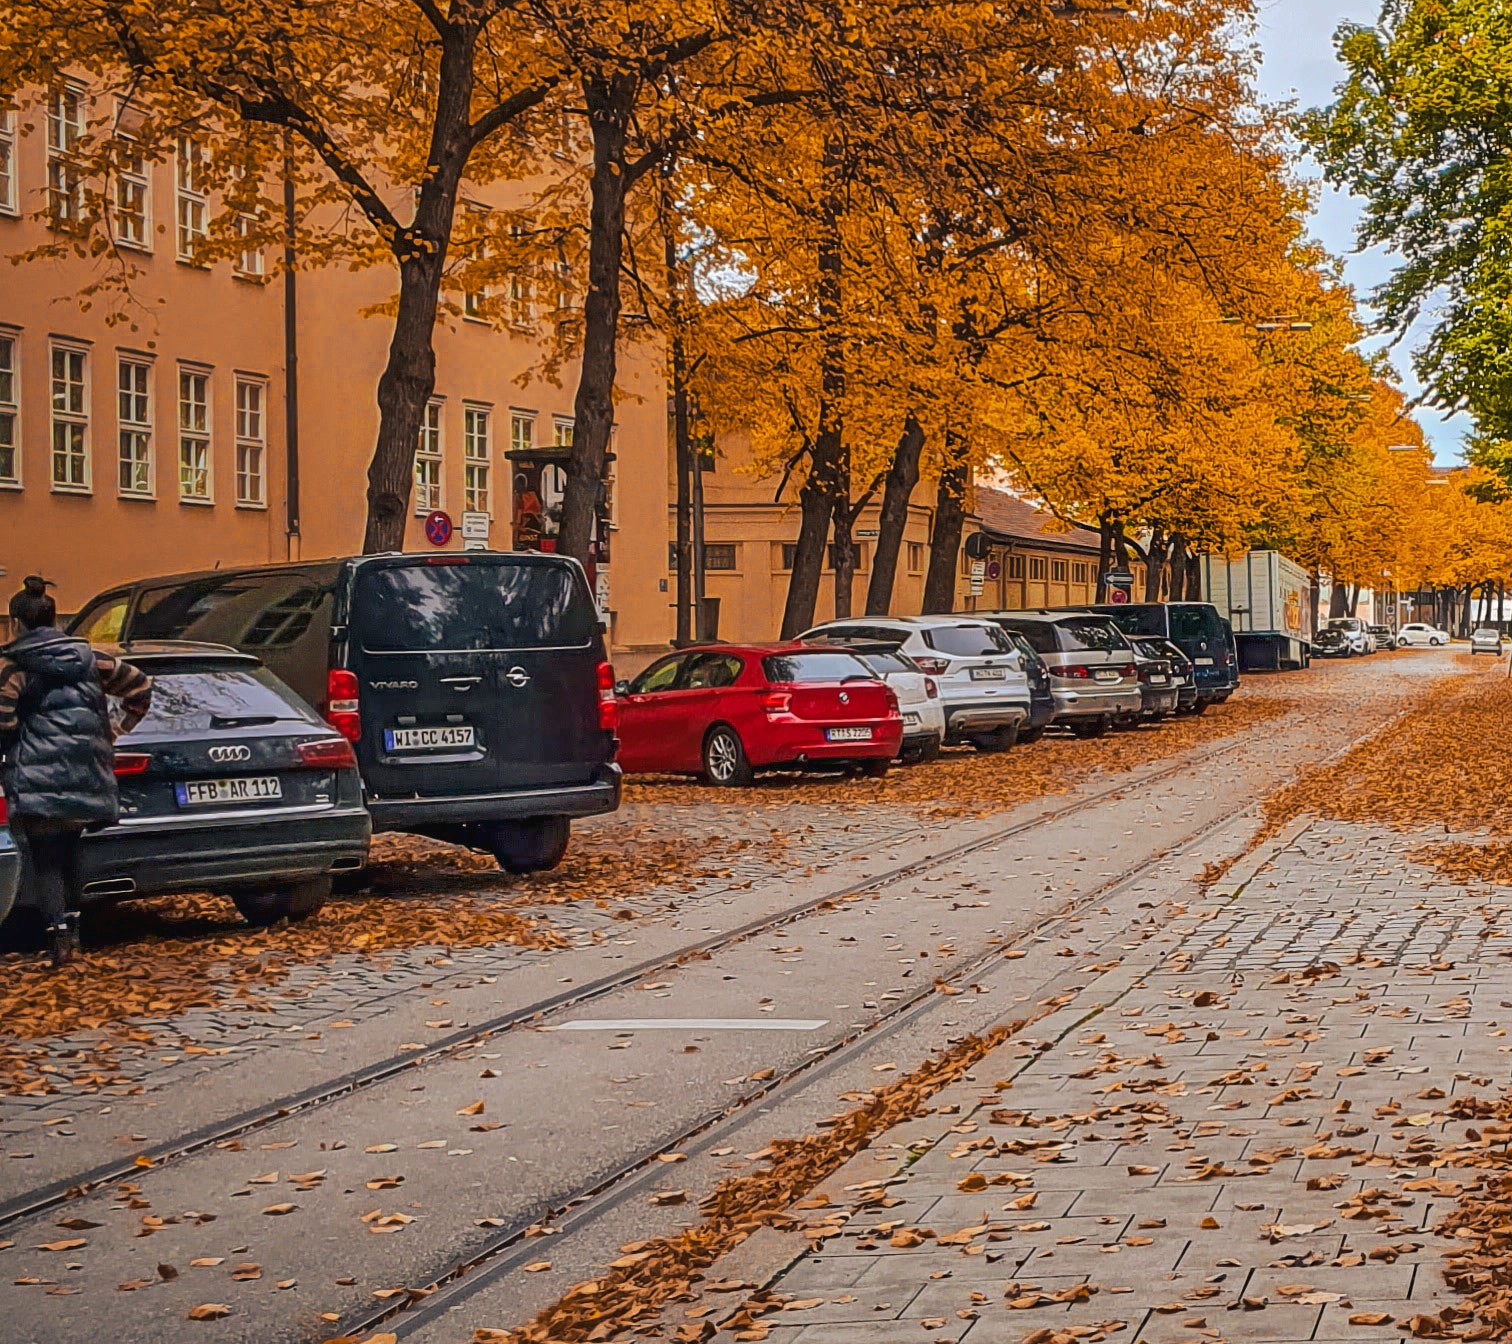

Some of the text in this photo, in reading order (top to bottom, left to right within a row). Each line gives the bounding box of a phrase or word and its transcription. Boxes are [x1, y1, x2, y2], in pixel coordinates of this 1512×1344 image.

[369, 680, 419, 689] VIVARO
[395, 729, 472, 747] WI CC 4157
[187, 778, 280, 801] FFB AR 112
